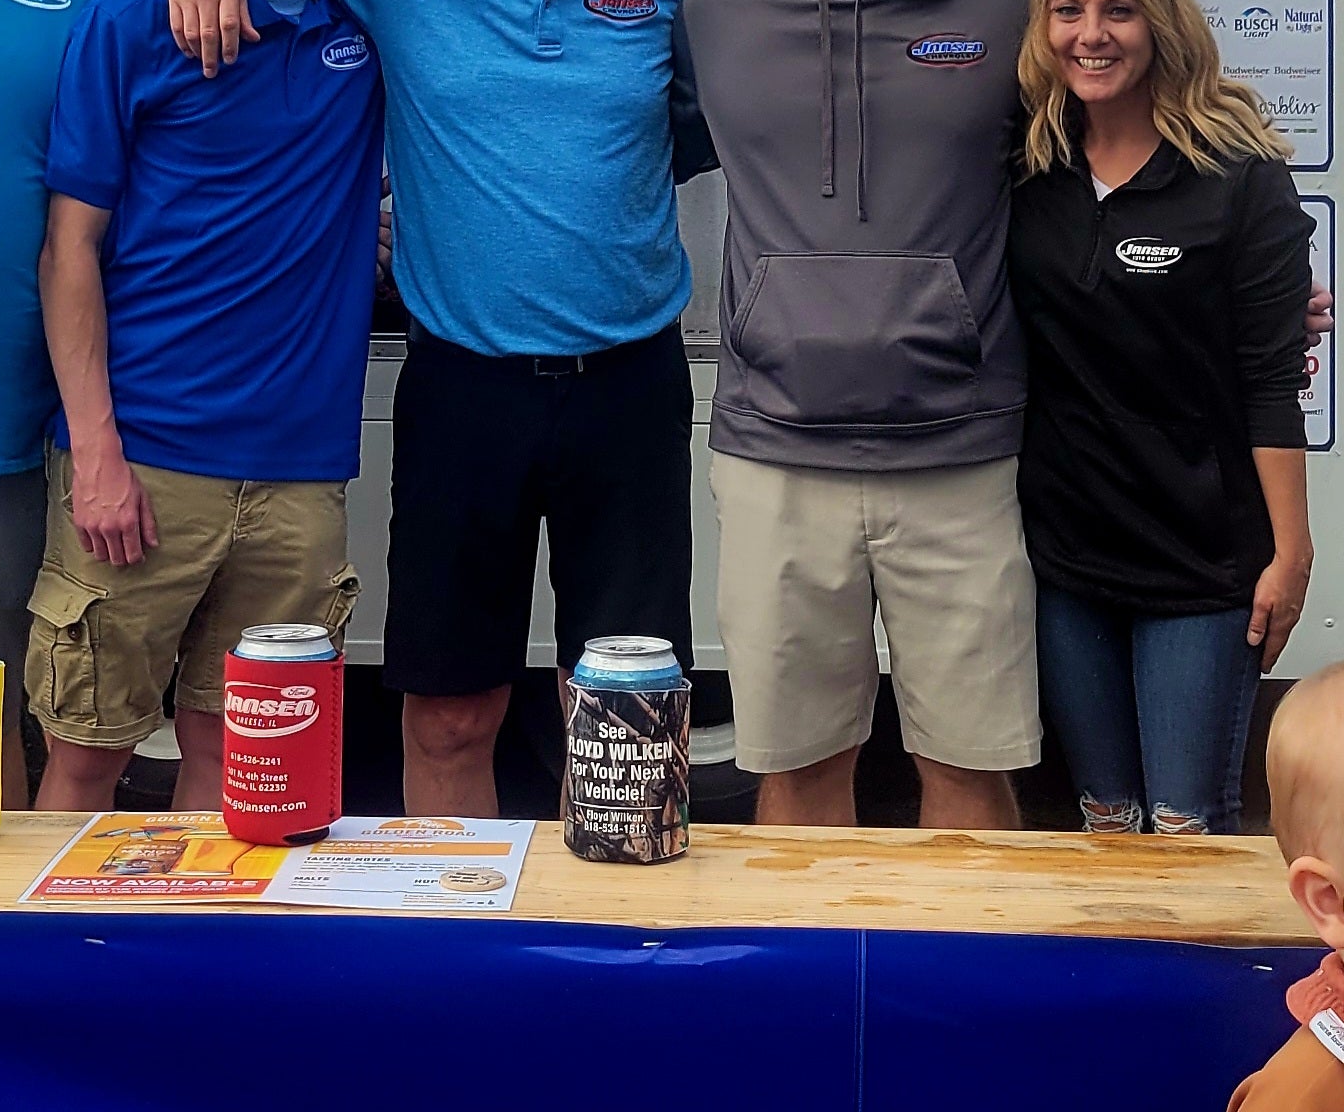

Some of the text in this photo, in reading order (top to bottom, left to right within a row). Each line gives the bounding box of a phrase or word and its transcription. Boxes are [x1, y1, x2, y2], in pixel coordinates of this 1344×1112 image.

[1285, 8, 1323, 22] Natural
[1235, 19, 1279, 31] BUSCH
[1259, 96, 1321, 114] arbliss
[599, 722, 626, 740] See
[568, 735, 672, 761] FLOYD WILKEN
[230, 752, 281, 766] 618-526-2241
[237, 770, 288, 782] N. 4th Street
[572, 758, 665, 780] For Your Next
[250, 783, 258, 791] IL
[259, 784, 286, 792] 62230
[584, 781, 645, 801] Vehicle!
[586, 809, 643, 822] Floyd Wilken
